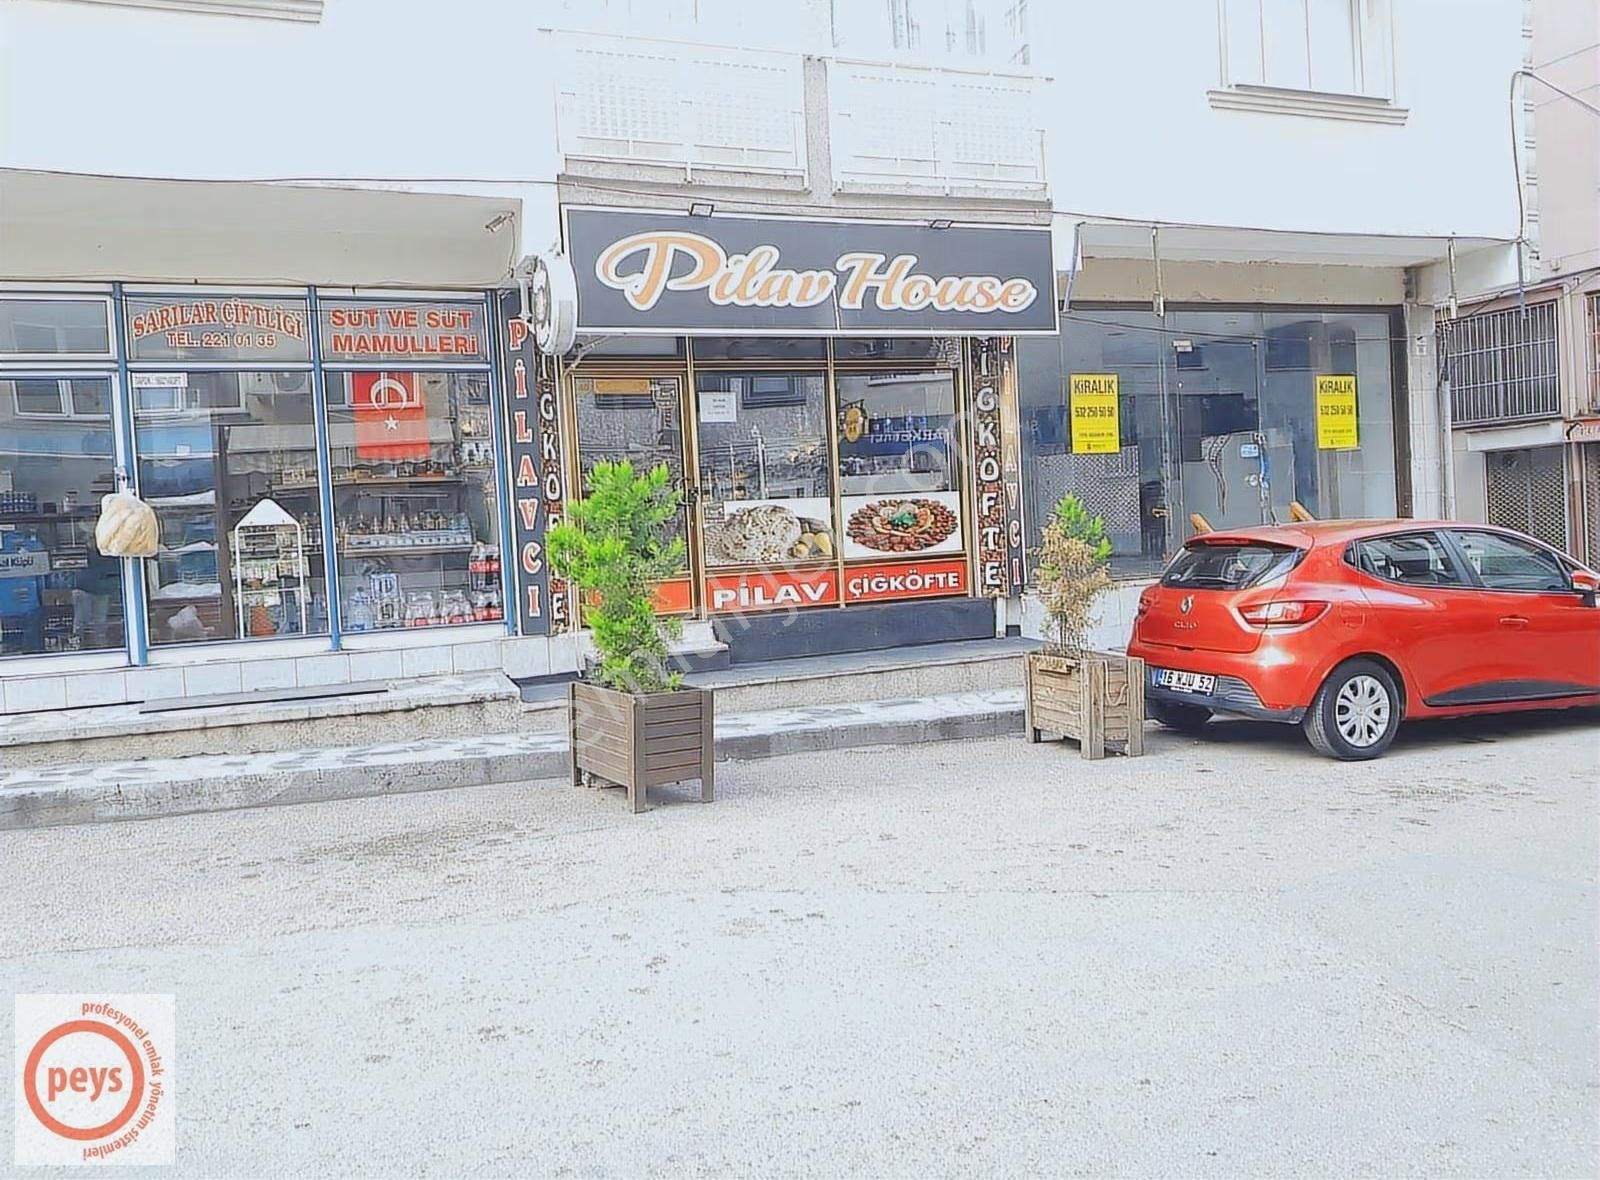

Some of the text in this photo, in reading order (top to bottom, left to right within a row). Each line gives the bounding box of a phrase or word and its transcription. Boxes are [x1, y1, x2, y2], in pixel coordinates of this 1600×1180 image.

[595, 230, 1038, 314] Pilav House
[132, 301, 216, 340] SARILAR
[387, 309, 418, 328] VE
[167, 331, 276, 348] TEL. 221 01 35
[712, 581, 830, 610] PİLAV
[848, 569, 960, 598] ÇİĞKÖFTE
